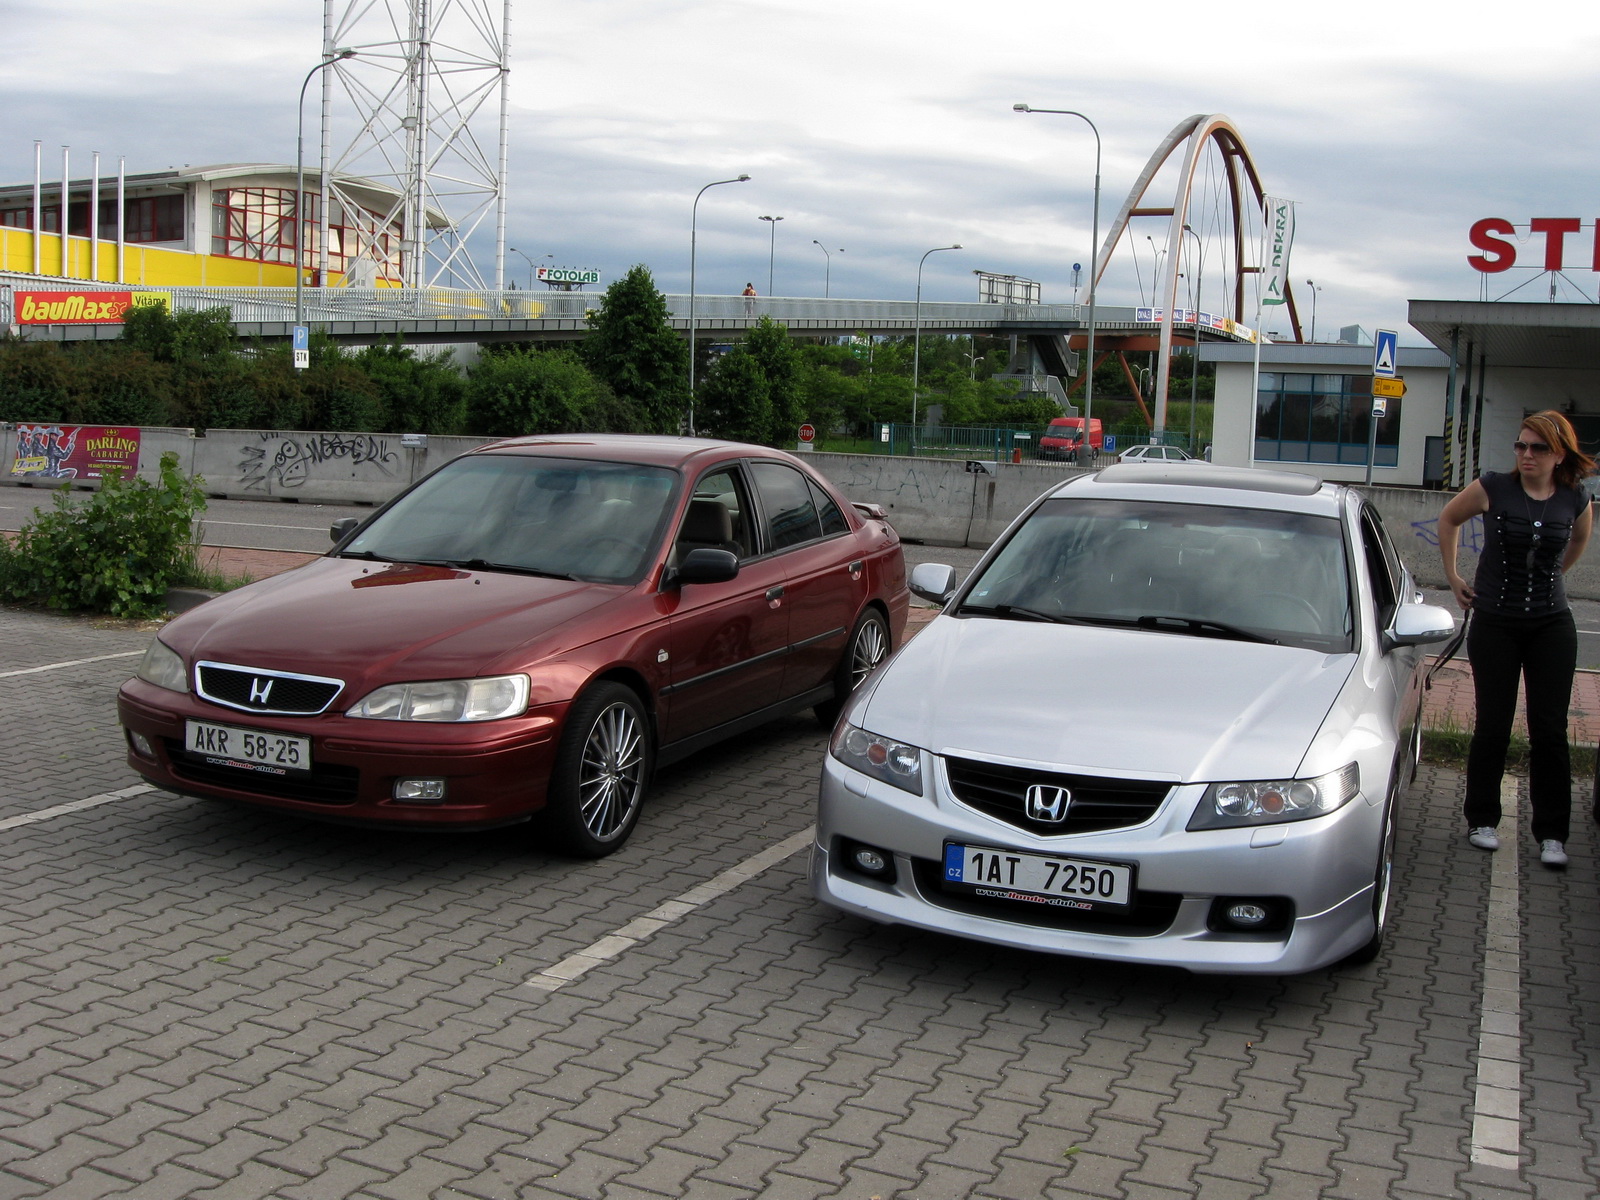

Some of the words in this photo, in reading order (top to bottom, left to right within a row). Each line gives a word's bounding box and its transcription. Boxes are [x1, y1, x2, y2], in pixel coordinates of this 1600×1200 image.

[1271, 205, 1287, 267] DEKRA
[1466, 217, 1600, 273] ST
[547, 269, 599, 282] FOTOLAB
[296, 352, 307, 361] STK
[800, 429, 814, 437] STOP
[86, 436, 137, 453] DARLING
[91, 450, 129, 459] CABARET
[195, 726, 229, 754] AKR
[243, 734, 300, 764] 58-25
[948, 868, 961, 878] CZ
[972, 852, 1021, 886] 1AT
[1043, 862, 1115, 898] 7250
